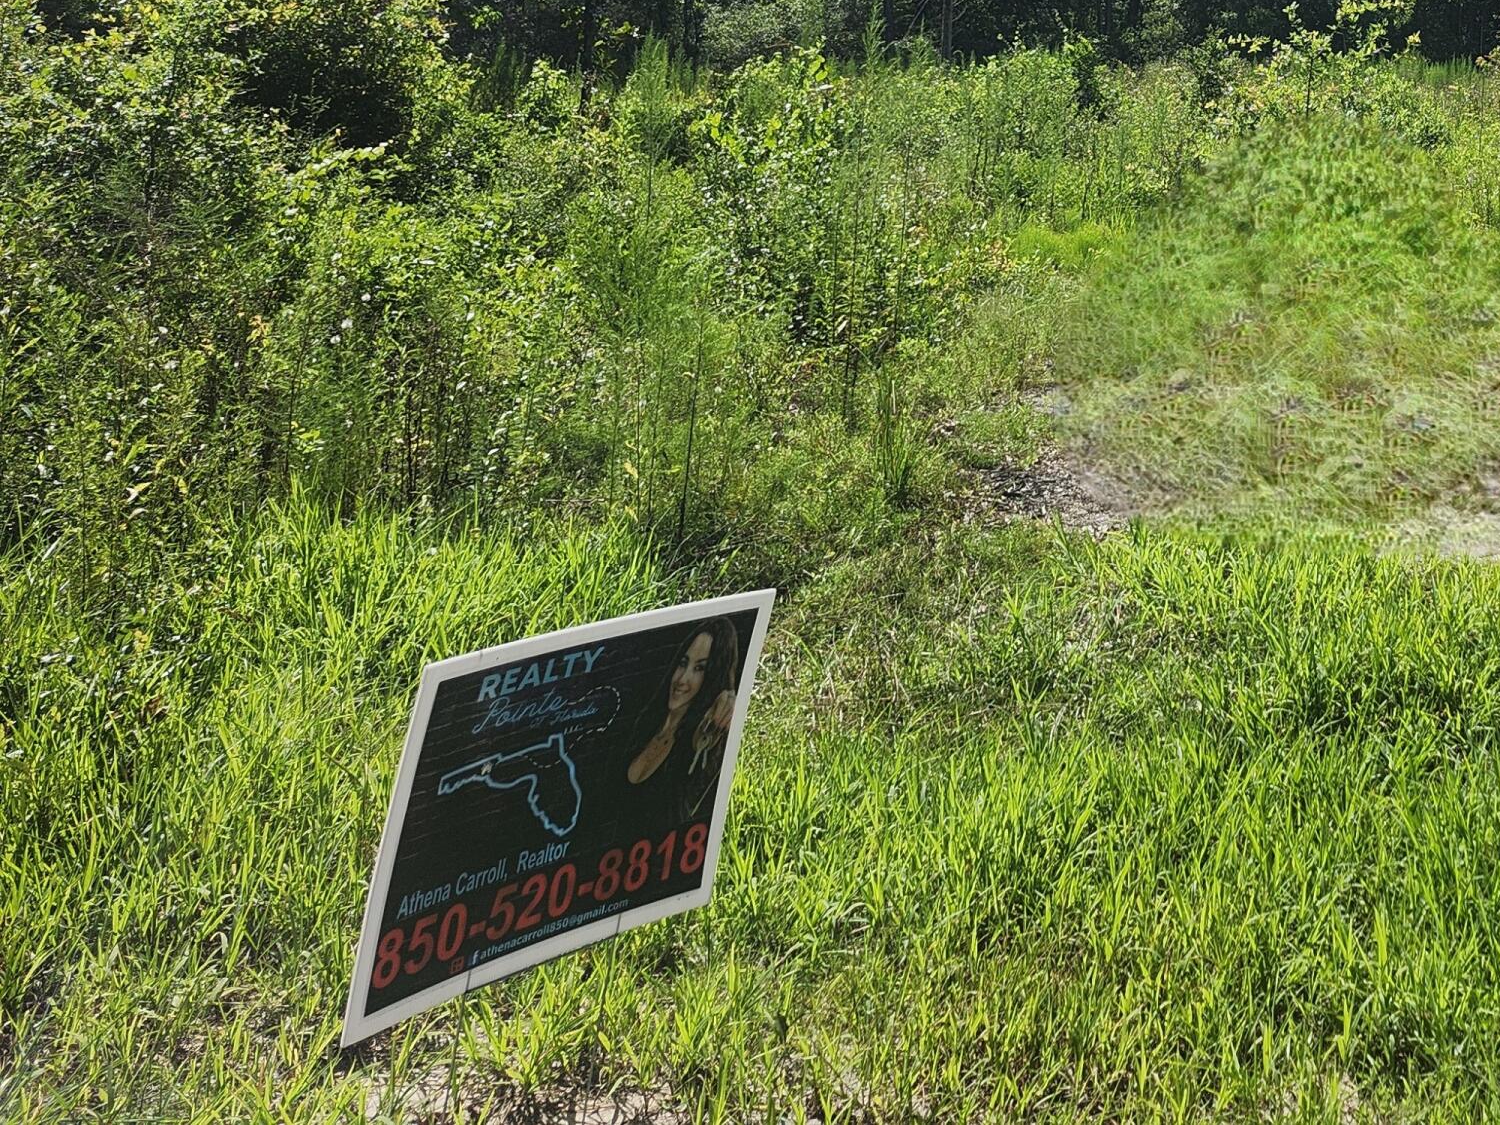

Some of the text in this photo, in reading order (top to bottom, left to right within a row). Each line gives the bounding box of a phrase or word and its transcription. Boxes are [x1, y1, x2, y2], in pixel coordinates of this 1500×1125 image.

[477, 646, 605, 702] REALTY
[472, 687, 568, 734] Pointe
[372, 823, 708, 990] 850-520-8818
[396, 841, 571, 919] Athena Carroll, Realtor
[480, 898, 629, 961] athenacarroll850@gmail.com
